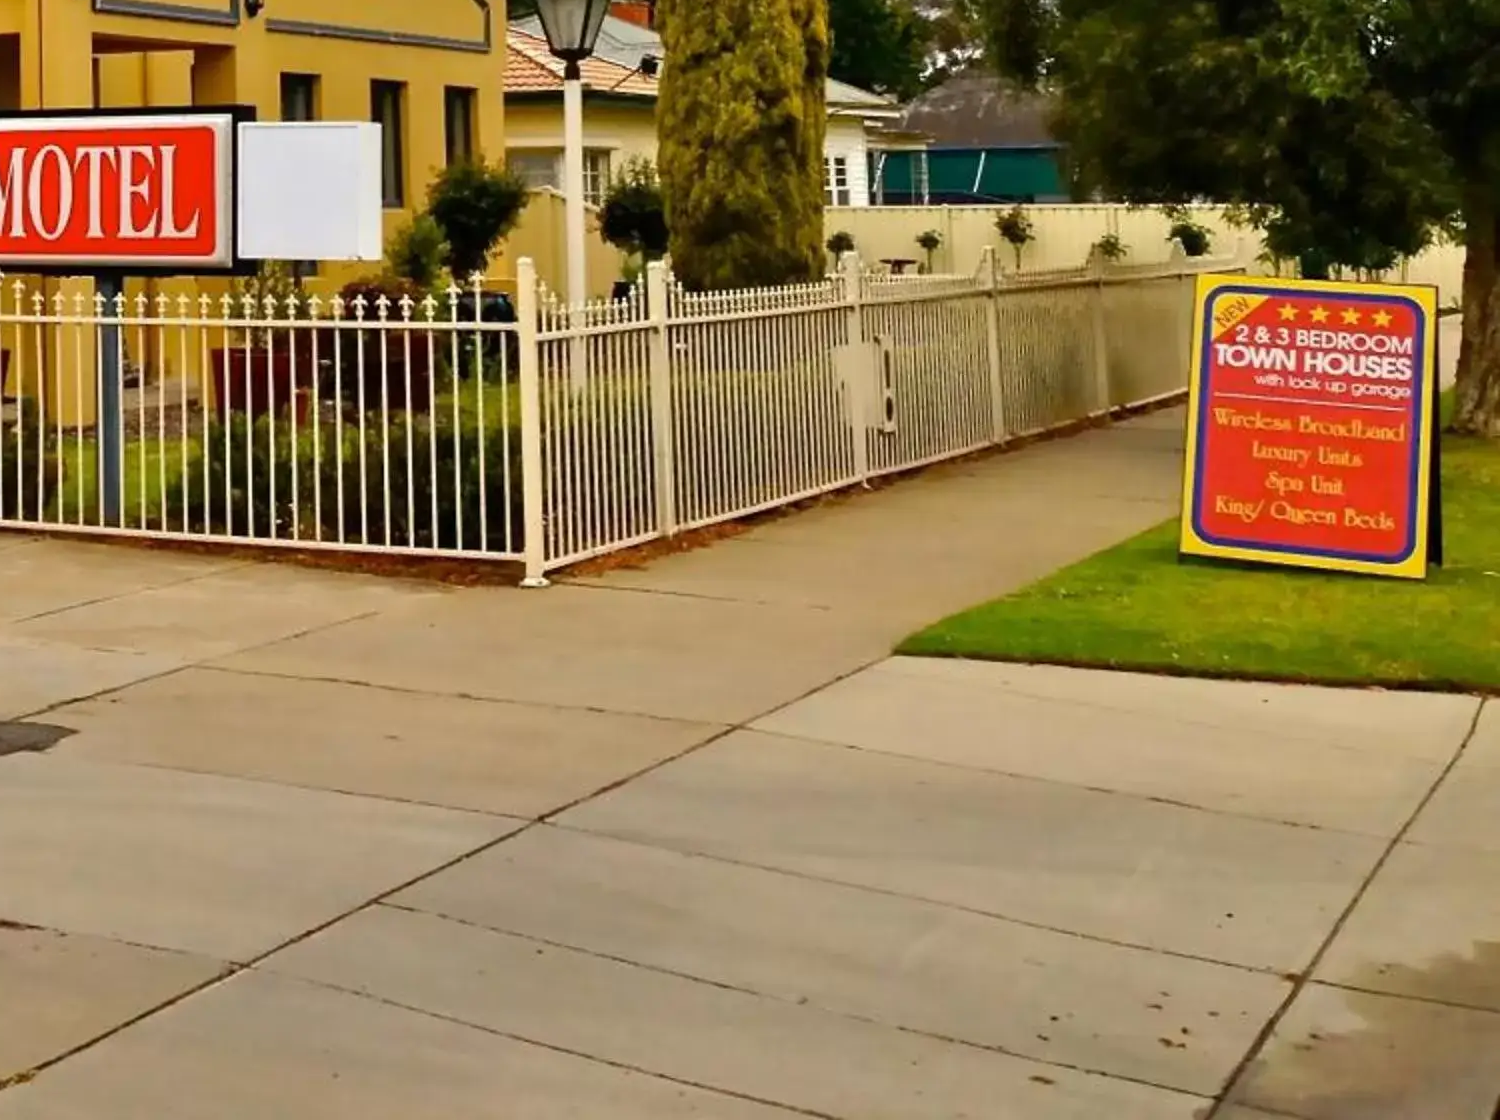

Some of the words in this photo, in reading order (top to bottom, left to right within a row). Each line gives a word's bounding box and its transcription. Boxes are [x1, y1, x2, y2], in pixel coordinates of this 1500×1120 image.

[1214, 297, 1249, 329] NEW
[1236, 324, 1248, 342] 2
[1254, 326, 1271, 344] &
[1276, 327, 1289, 345] 3
[1296, 330, 1412, 354] BEDROOM
[1215, 344, 1296, 371] TOWN
[1304, 351, 1412, 380] HOUSES
[1254, 374, 1284, 387] with
[1289, 376, 1320, 390] lock
[1326, 382, 1346, 393] up
[1352, 383, 1411, 400] garage
[1213, 407, 1291, 431] Wireless
[1299, 415, 1405, 441] Broadband
[1252, 441, 1311, 468] Luxury
[1319, 447, 1363, 467] Units
[1265, 471, 1303, 496] Spa
[1311, 476, 1344, 495] Unit
[1271, 501, 1336, 526] Queen
[1345, 509, 1395, 530] Beds
